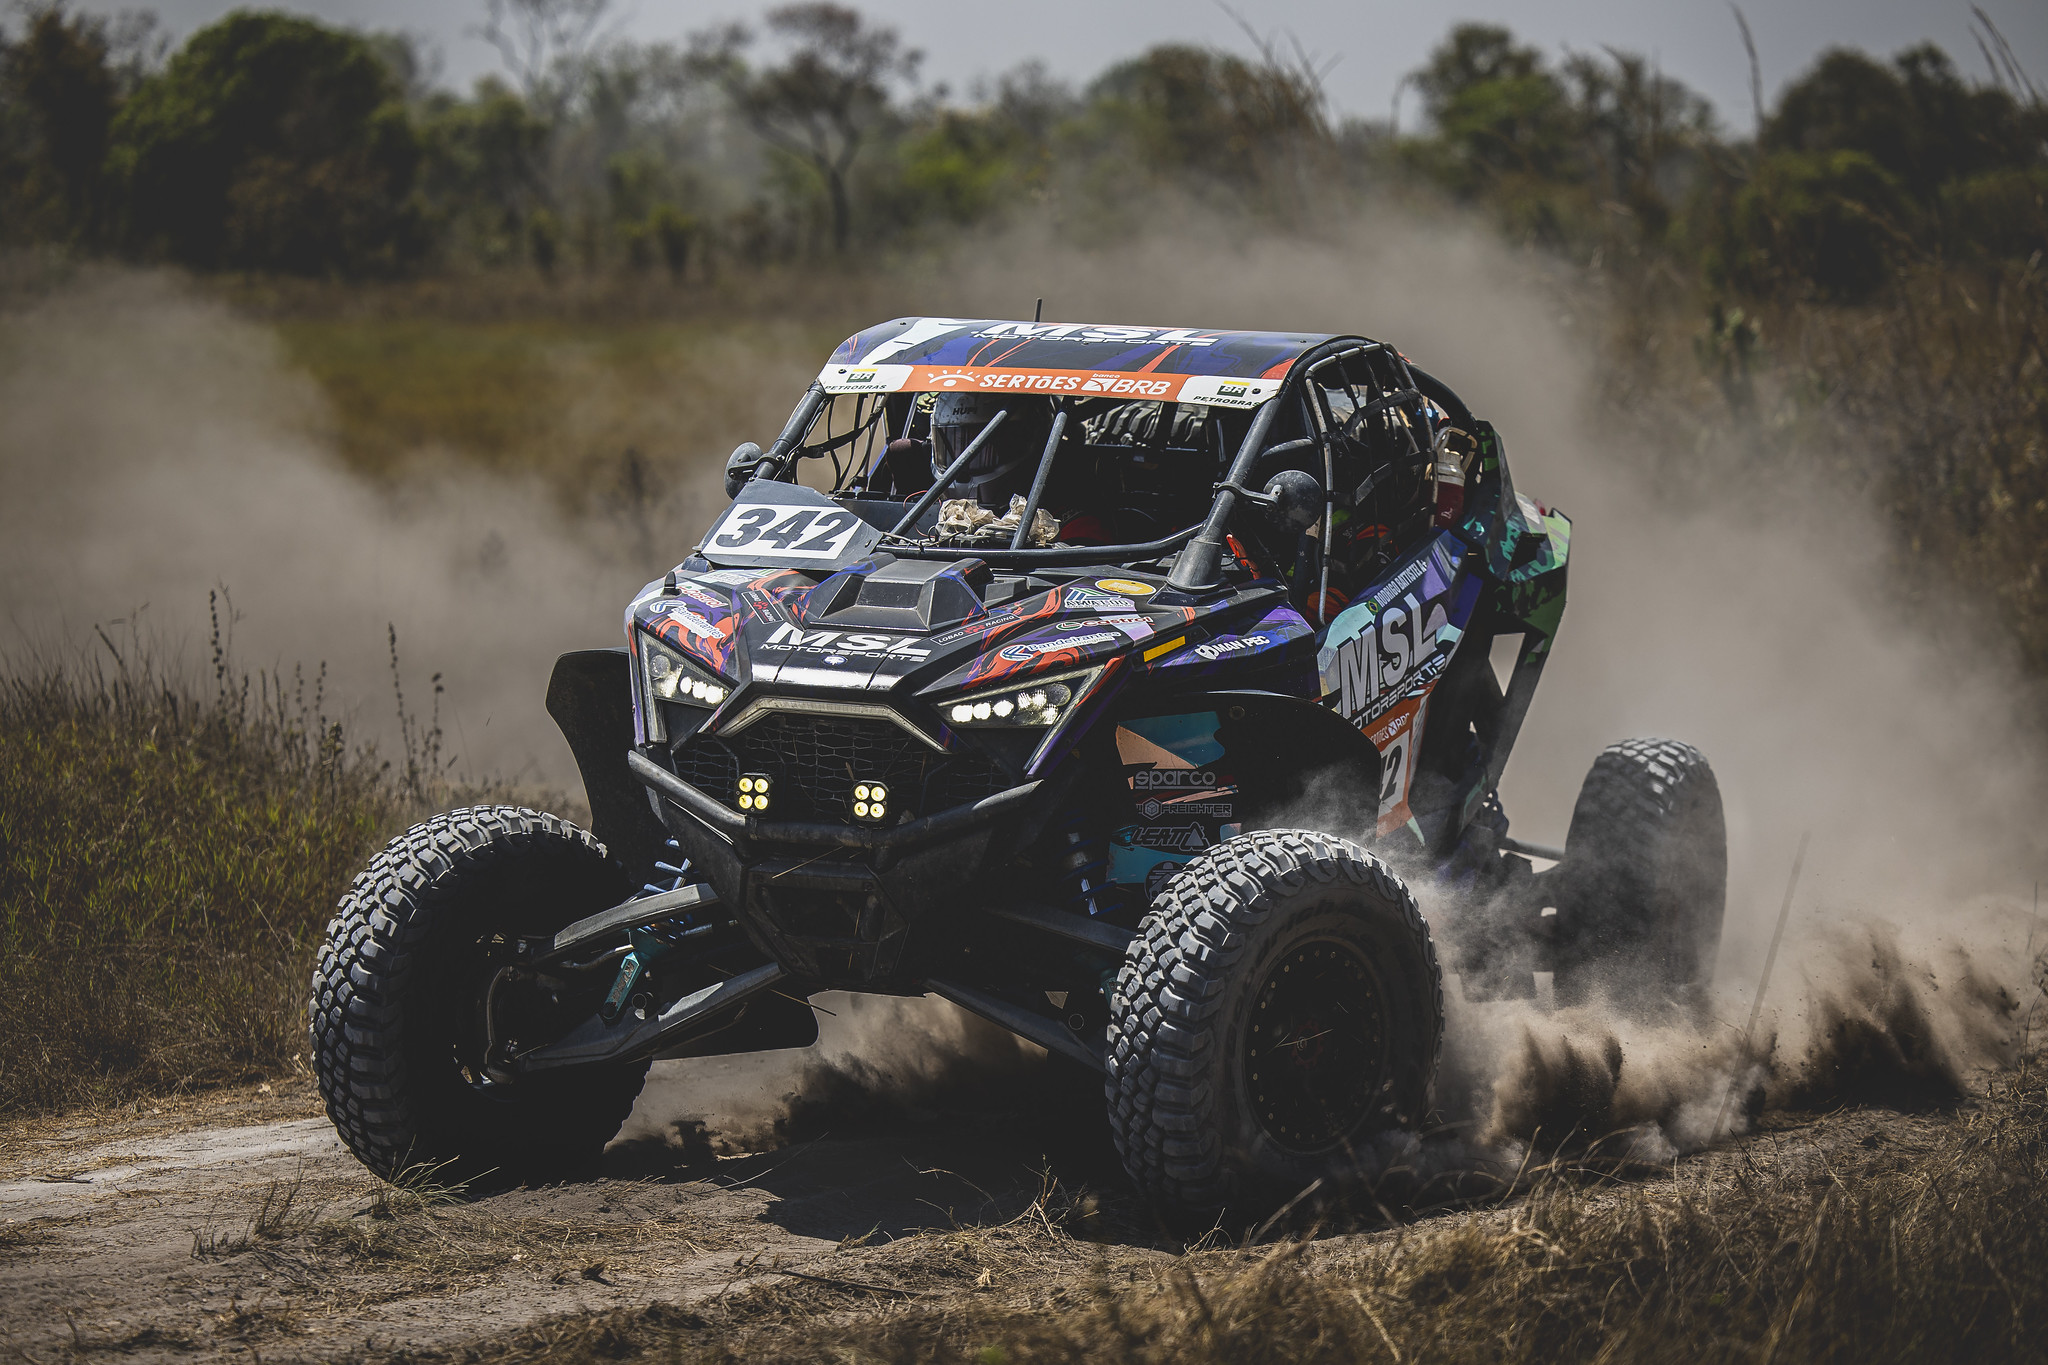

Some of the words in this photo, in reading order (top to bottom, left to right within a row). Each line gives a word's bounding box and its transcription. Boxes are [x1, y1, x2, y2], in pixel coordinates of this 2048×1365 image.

[981, 322, 1219, 341] MSL
[1111, 379, 1171, 395] BRB
[715, 508, 859, 551] 342
[985, 615, 1015, 627] RACING
[1083, 616, 1152, 627] Castrol
[765, 622, 932, 656] MSL
[1212, 640, 1245, 653] MAN
[1241, 635, 1270, 649] PEC
[760, 643, 927, 663] MOTORSPORTS
[1337, 592, 1438, 720] MSL
[1352, 653, 1446, 730] OTORSPORTS
[1135, 770, 1216, 790] sparco
[1161, 803, 1232, 814] FREIGHTER
